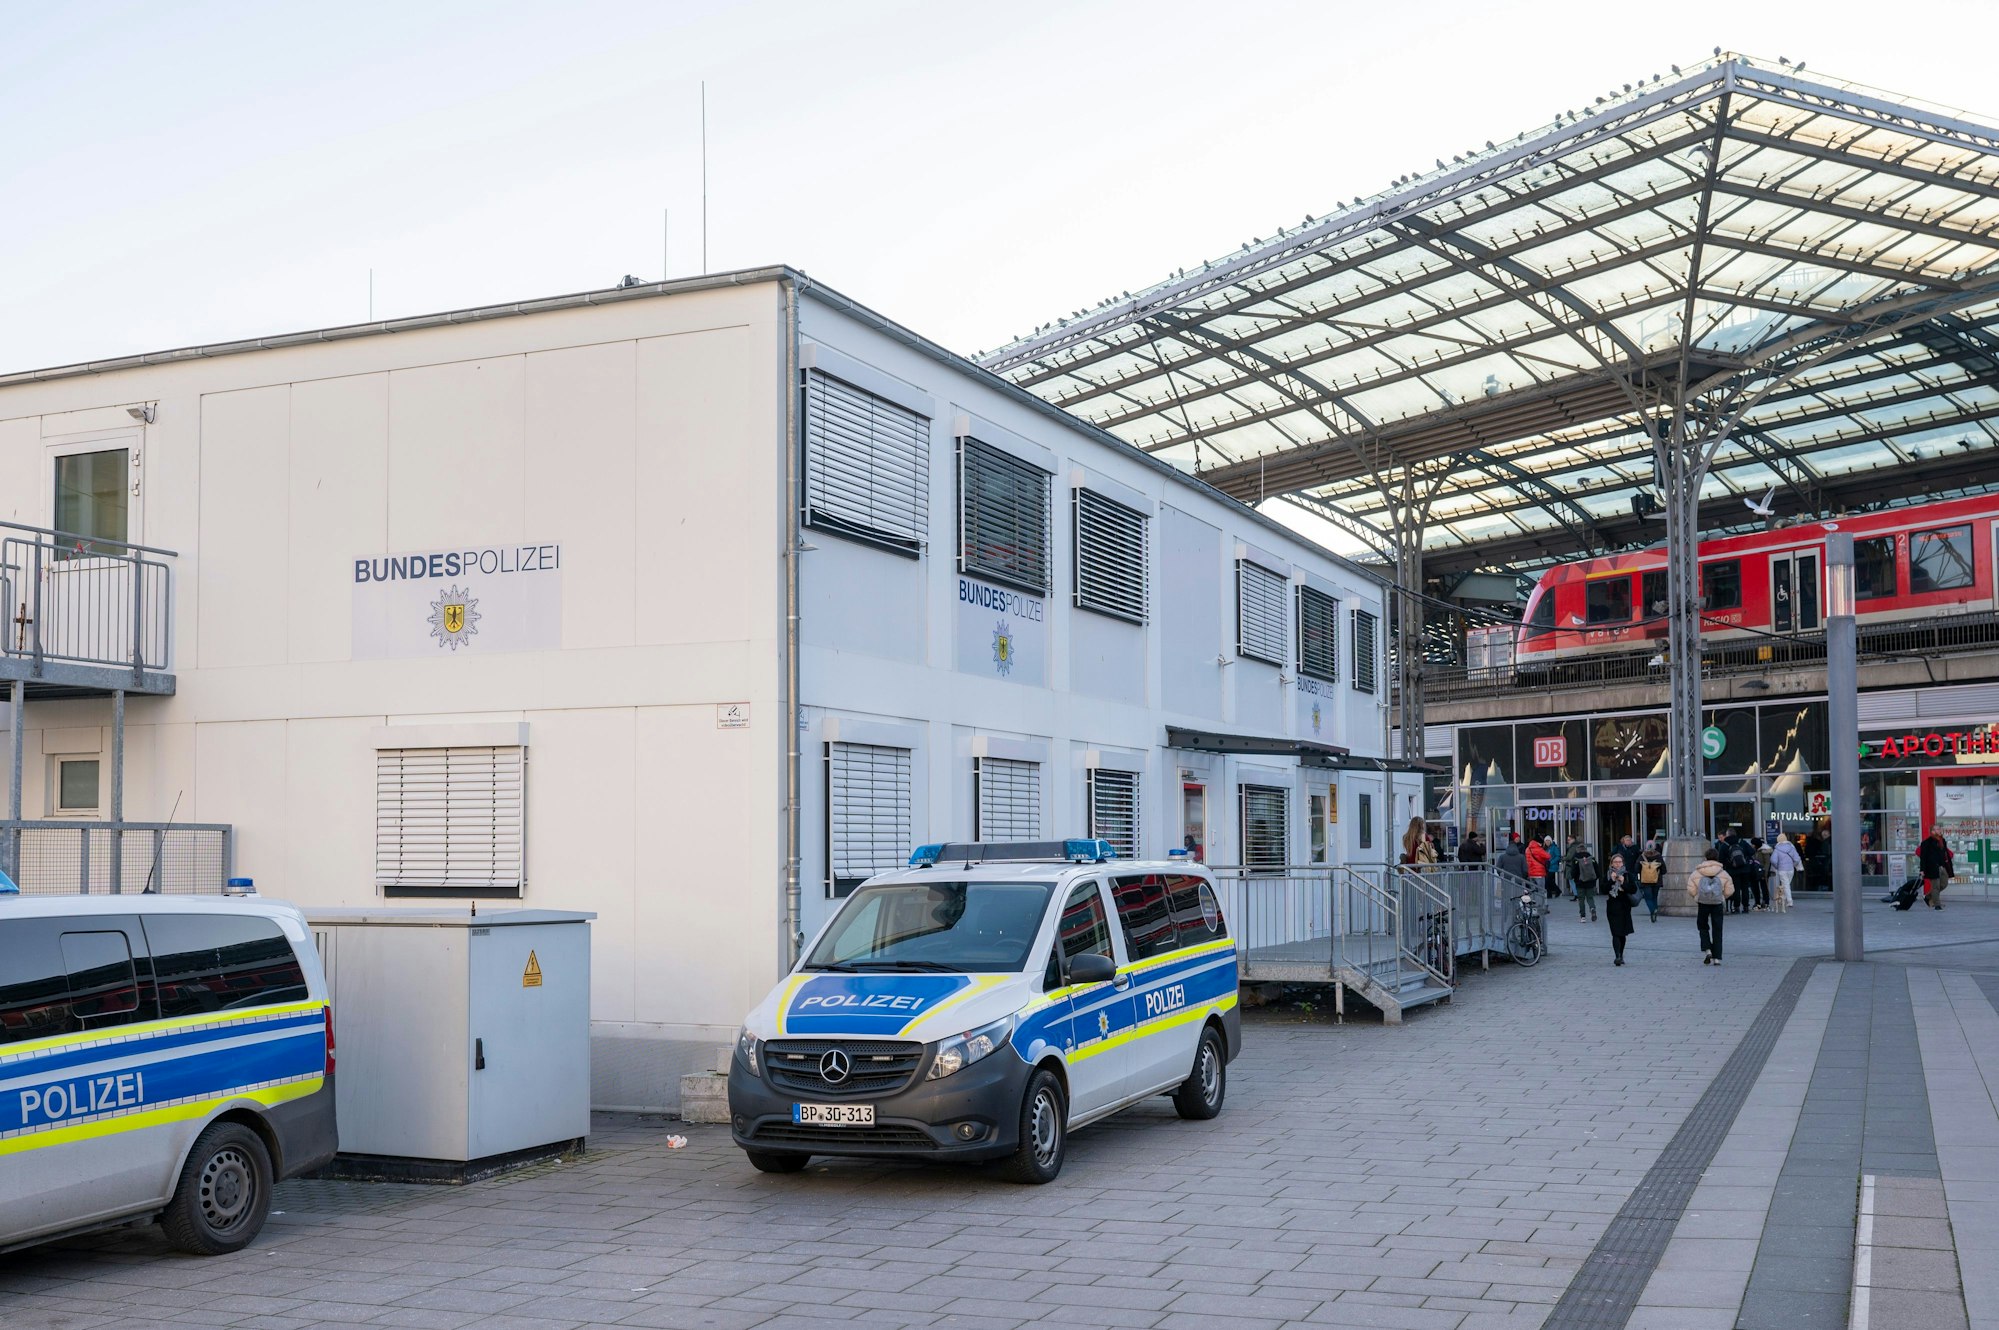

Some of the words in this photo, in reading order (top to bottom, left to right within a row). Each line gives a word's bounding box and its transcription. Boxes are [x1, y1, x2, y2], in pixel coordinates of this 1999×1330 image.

[1899, 534, 1906, 546] 2
[355, 545, 559, 583] BUNDESPOLIZEI
[960, 579, 1043, 622] BUNDESPOLIZEI
[1537, 741, 1562, 763] DB
[1703, 730, 1720, 756] S
[798, 994, 924, 1010] POLIZEI
[1145, 983, 1185, 1017] POLIZEI
[20, 1072, 144, 1124] POLIZEI
[801, 1106, 817, 1121] BP
[825, 1106, 872, 1122] 30-313
